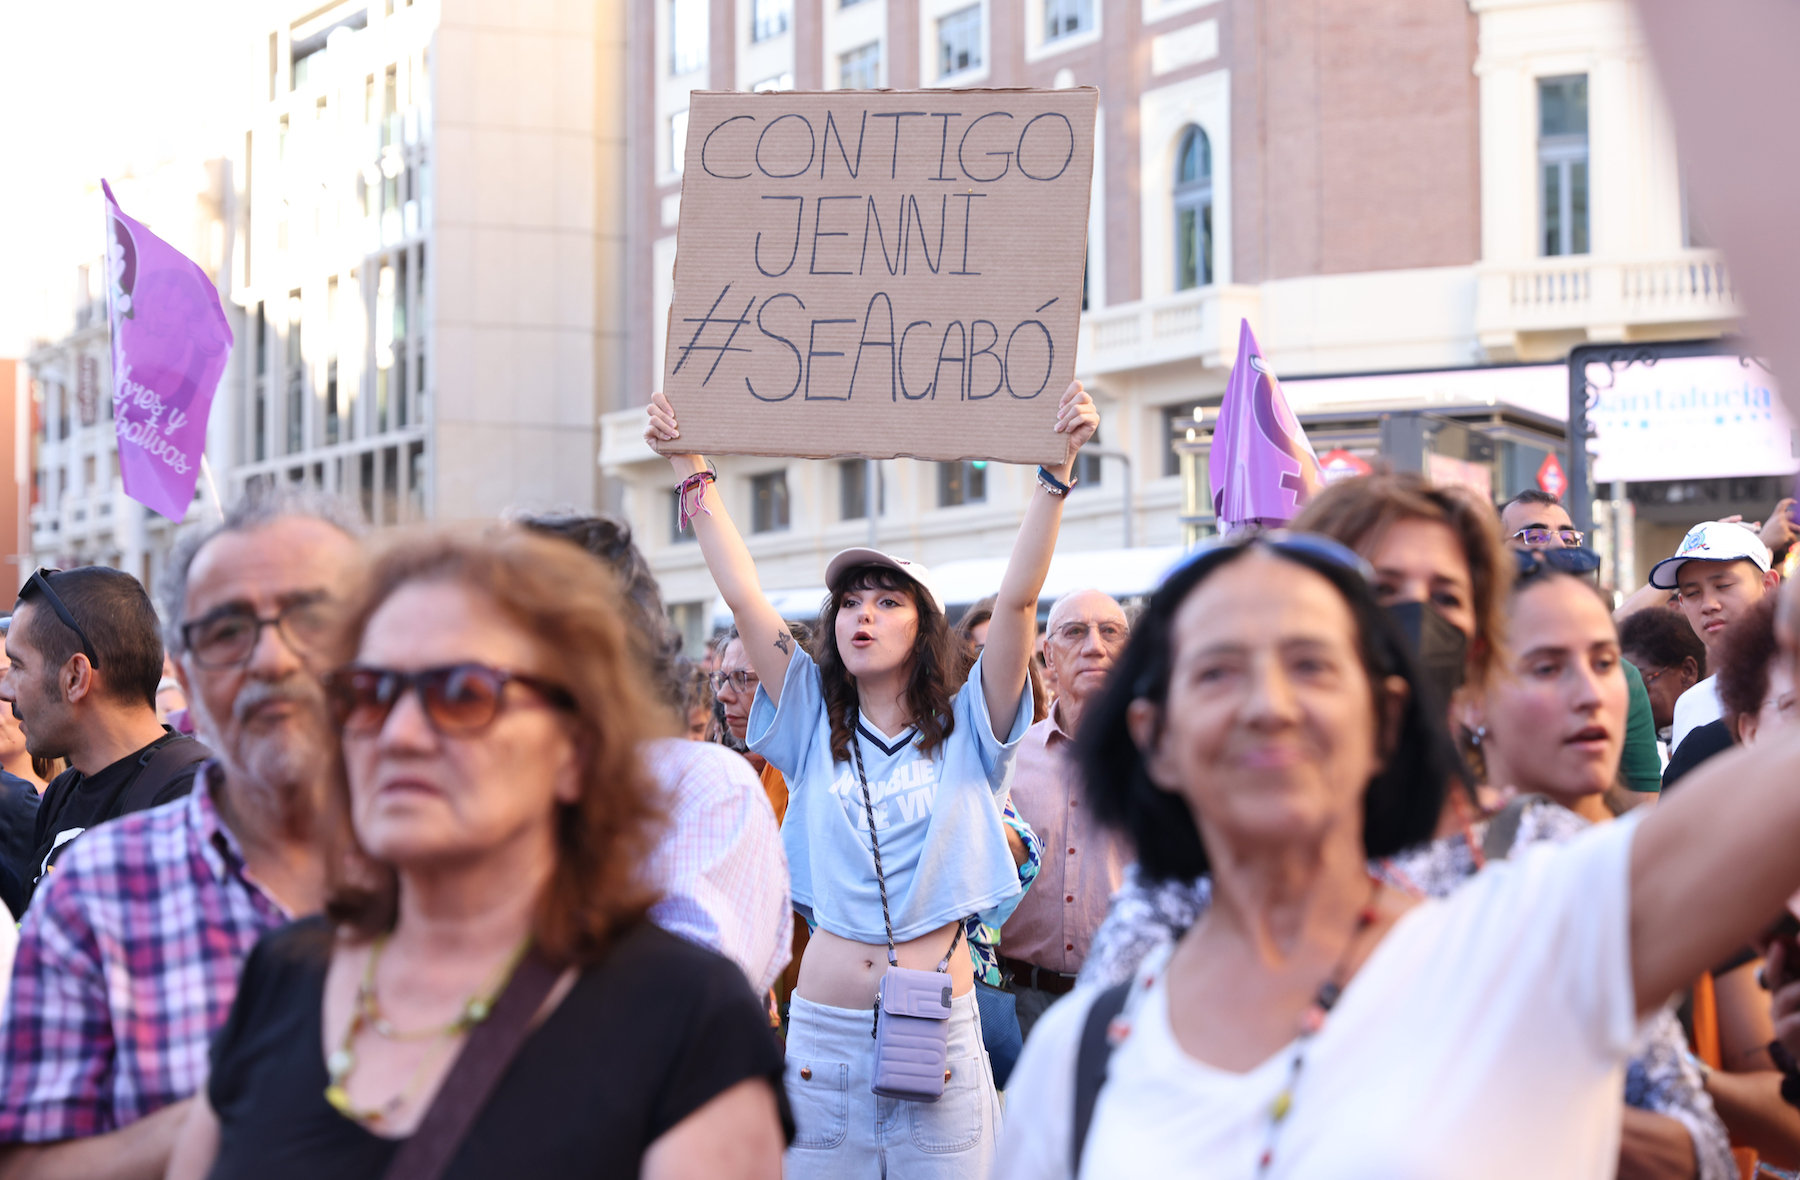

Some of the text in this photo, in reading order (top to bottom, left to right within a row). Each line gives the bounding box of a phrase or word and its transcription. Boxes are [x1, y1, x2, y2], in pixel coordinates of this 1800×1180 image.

[701, 110, 1075, 182] CONTIGO
[754, 193, 987, 277] JENNI
[115, 402, 192, 475] bativas
[164, 406, 188, 436] y
[895, 782, 939, 823] VIV
